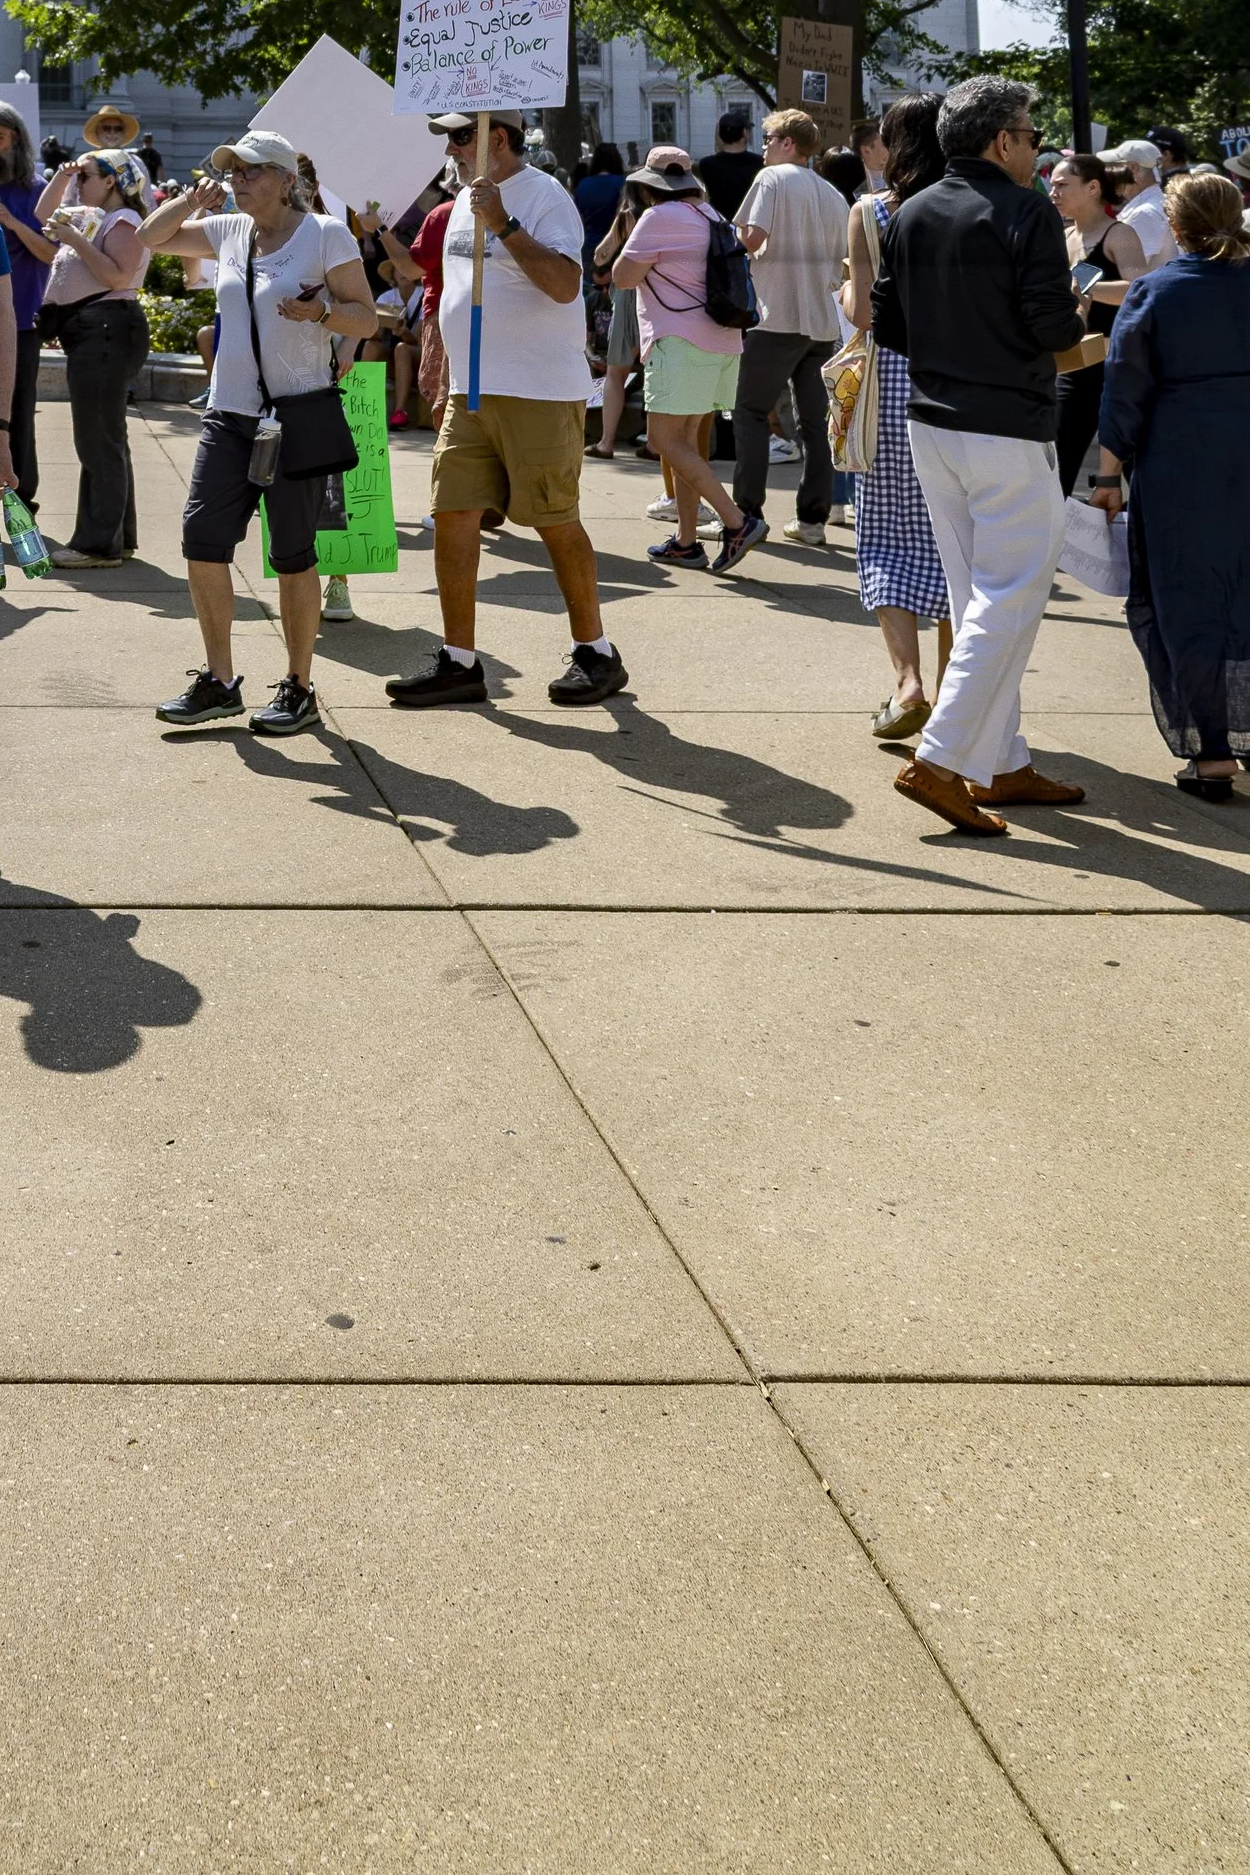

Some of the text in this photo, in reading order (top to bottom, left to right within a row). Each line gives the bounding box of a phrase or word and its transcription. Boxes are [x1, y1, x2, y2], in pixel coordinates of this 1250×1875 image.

[413, 0, 441, 23] The
[444, 0, 472, 17] rule
[409, 10, 533, 56] Equal Justice
[411, 35, 554, 77] Balance of Power
[466, 66, 477, 76] NO
[465, 79, 490, 93] KINGS
[350, 395, 379, 419] Bitch
[345, 467, 385, 494] SLUT!
[358, 533, 397, 565] Trump
